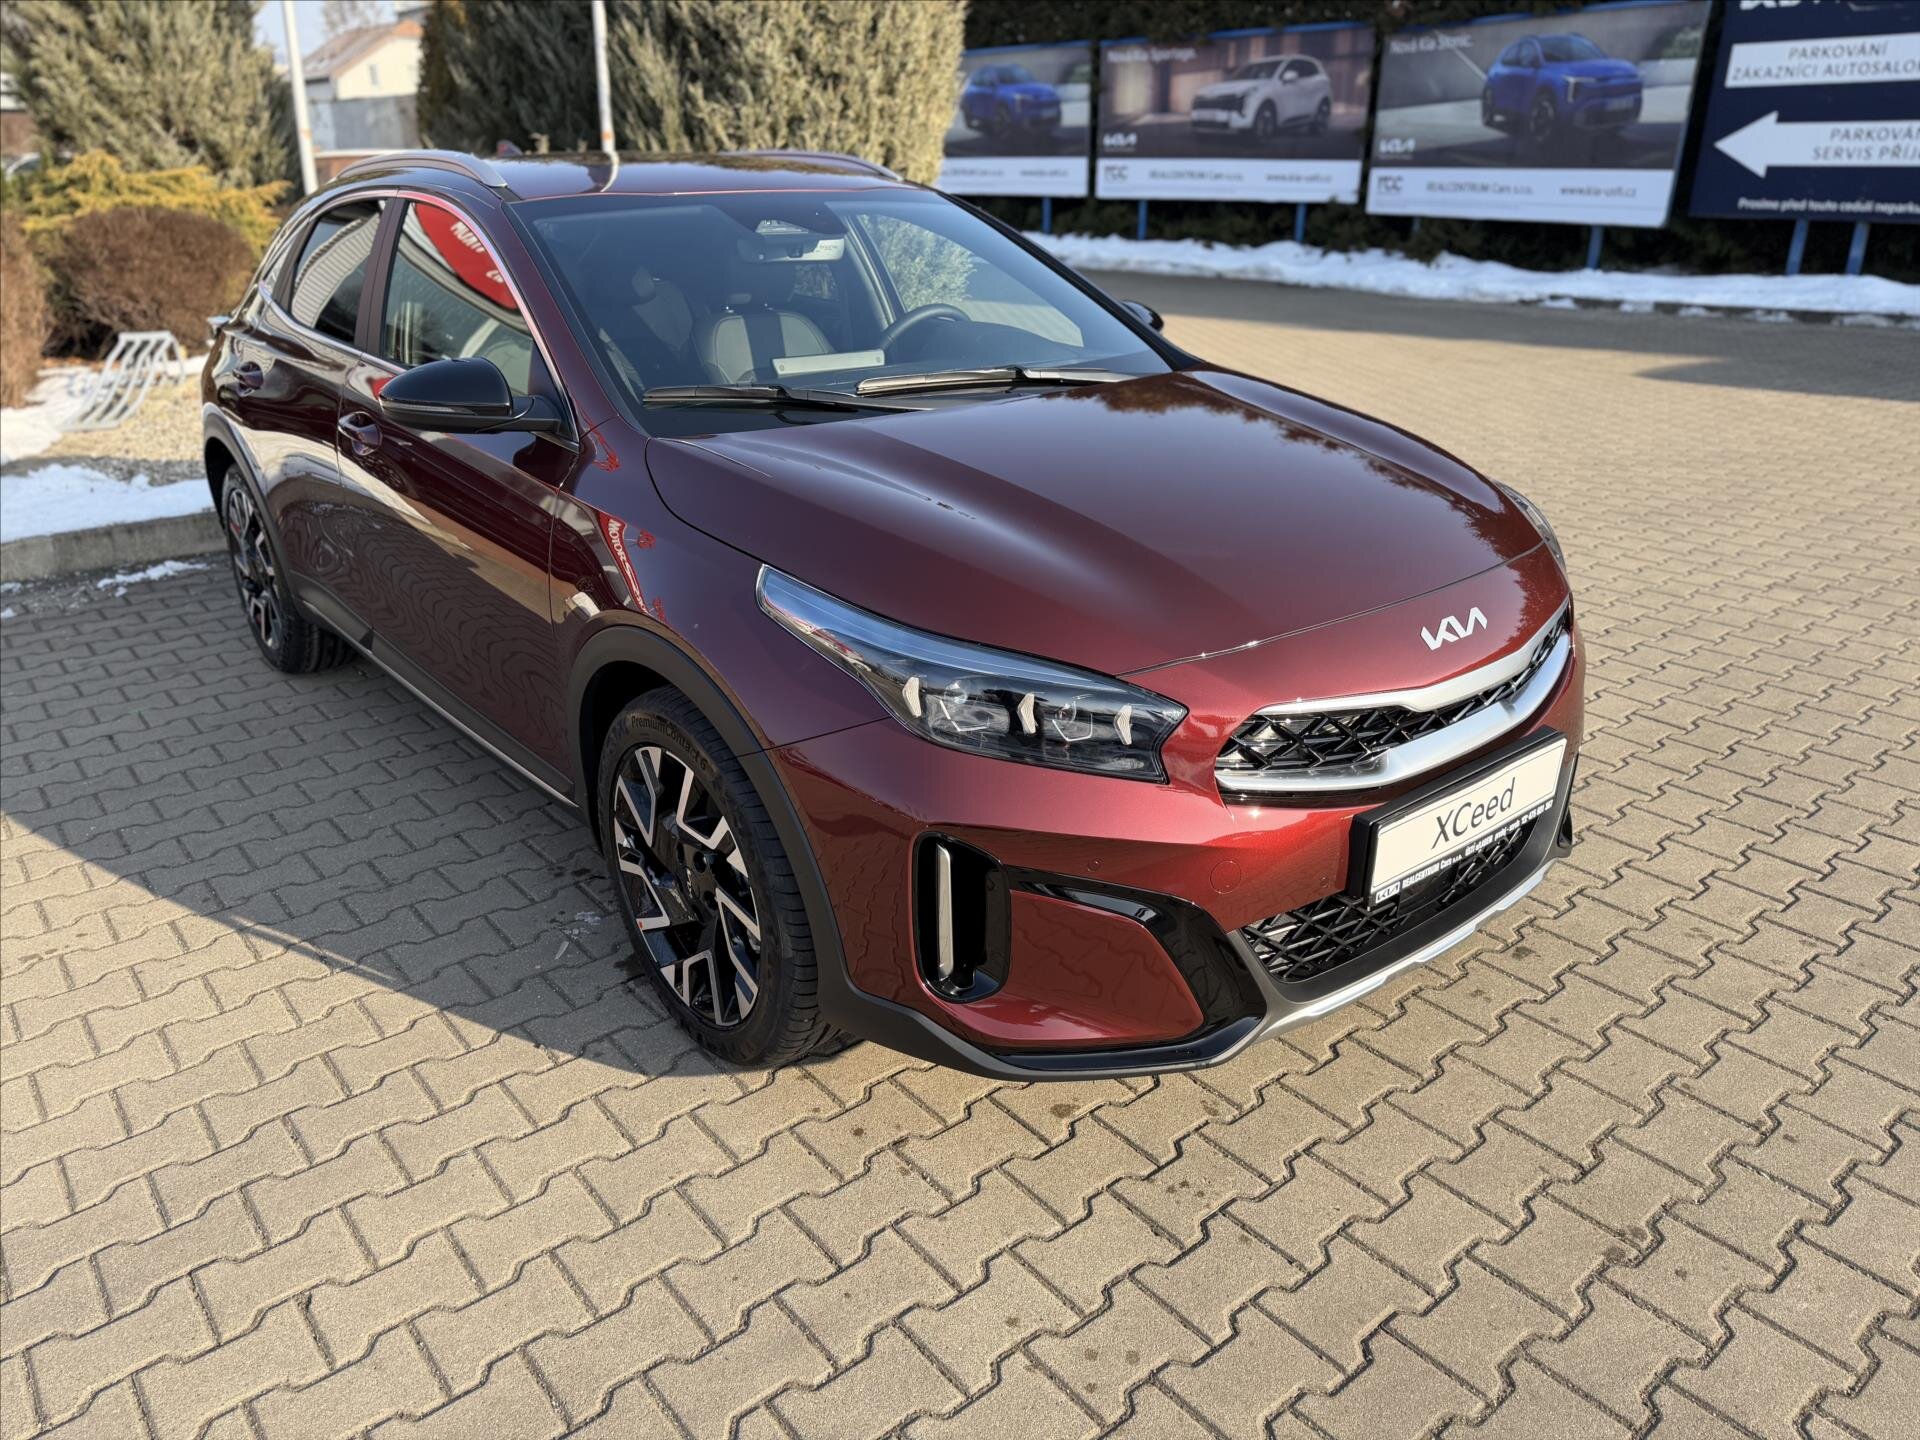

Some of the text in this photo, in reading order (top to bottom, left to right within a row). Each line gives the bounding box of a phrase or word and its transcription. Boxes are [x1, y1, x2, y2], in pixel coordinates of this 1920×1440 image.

[1789, 41, 1889, 60] PARKOVÁNÍ
[1822, 58, 1920, 77] AUTOSALO
[1811, 142, 1920, 161] SERVIS PŘÍJ
[1420, 606, 1488, 651] KIA
[631, 715, 701, 761] PremiumContact
[1431, 777, 1516, 850] XCeed
